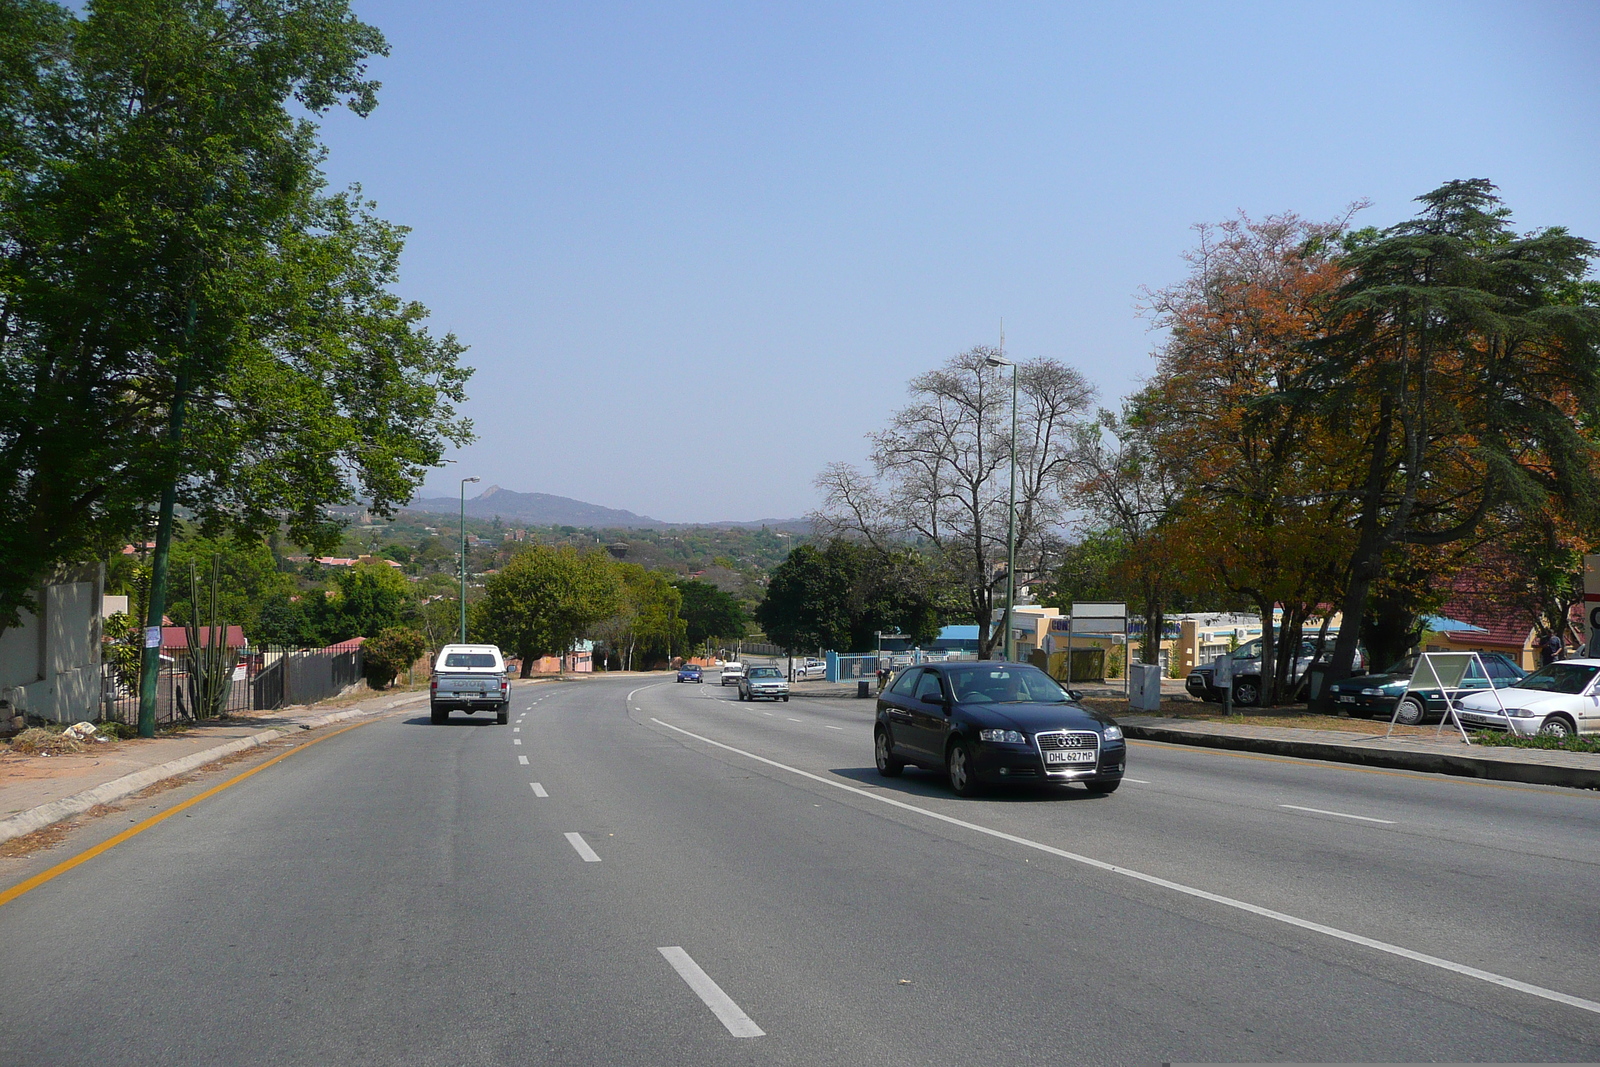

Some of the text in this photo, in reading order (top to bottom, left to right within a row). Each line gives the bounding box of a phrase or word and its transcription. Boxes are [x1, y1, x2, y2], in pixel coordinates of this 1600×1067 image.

[452, 680, 487, 688] TOYOTA
[1049, 751, 1093, 762] DHL 627 MP
